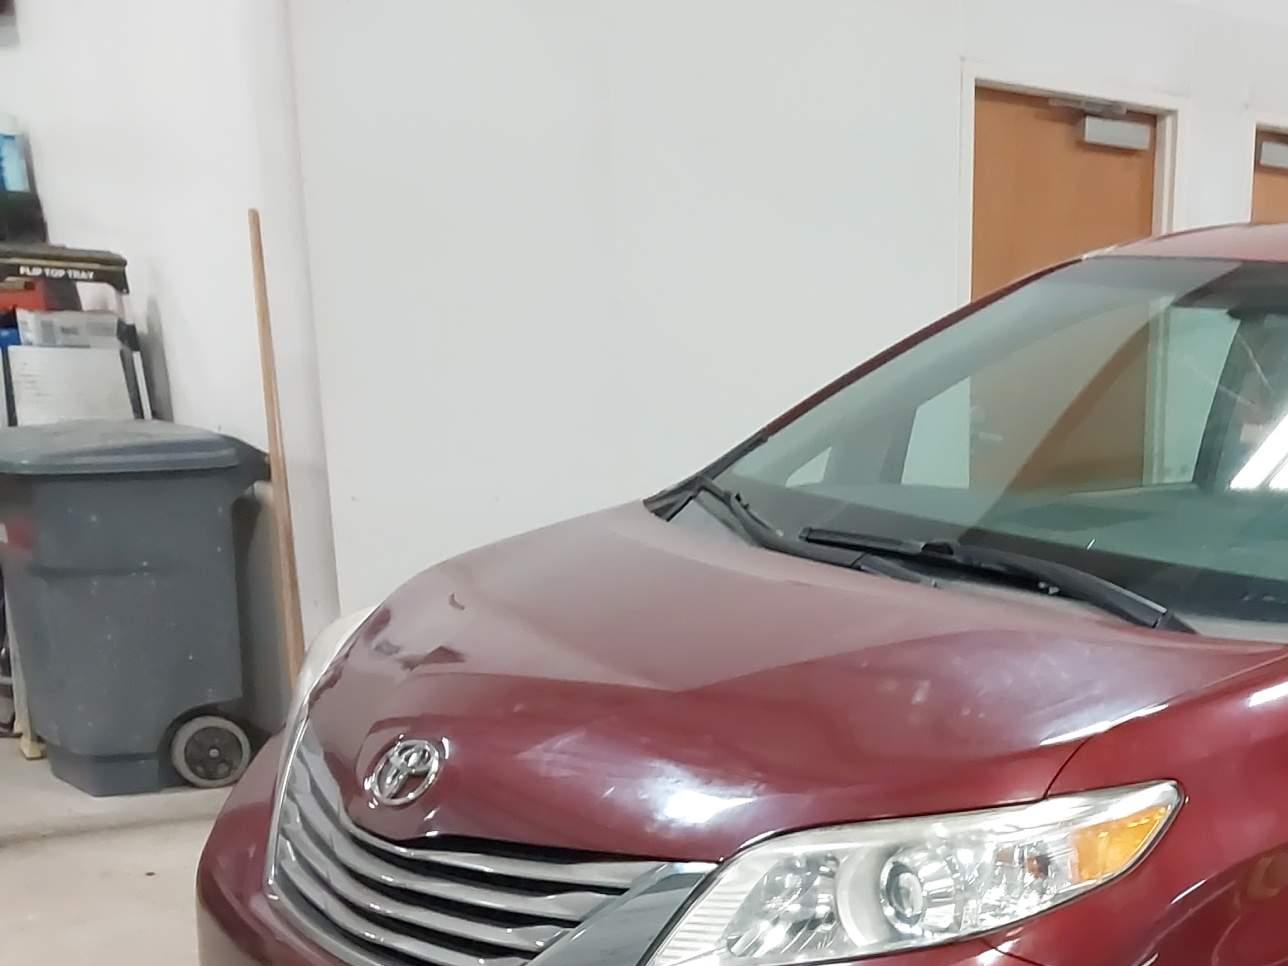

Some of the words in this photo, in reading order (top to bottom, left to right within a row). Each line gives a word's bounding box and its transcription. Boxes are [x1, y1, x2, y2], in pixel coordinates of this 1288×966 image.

[19, 265, 42, 277] FLIP
[44, 267, 66, 279] TOP
[67, 269, 95, 280] TRAY
